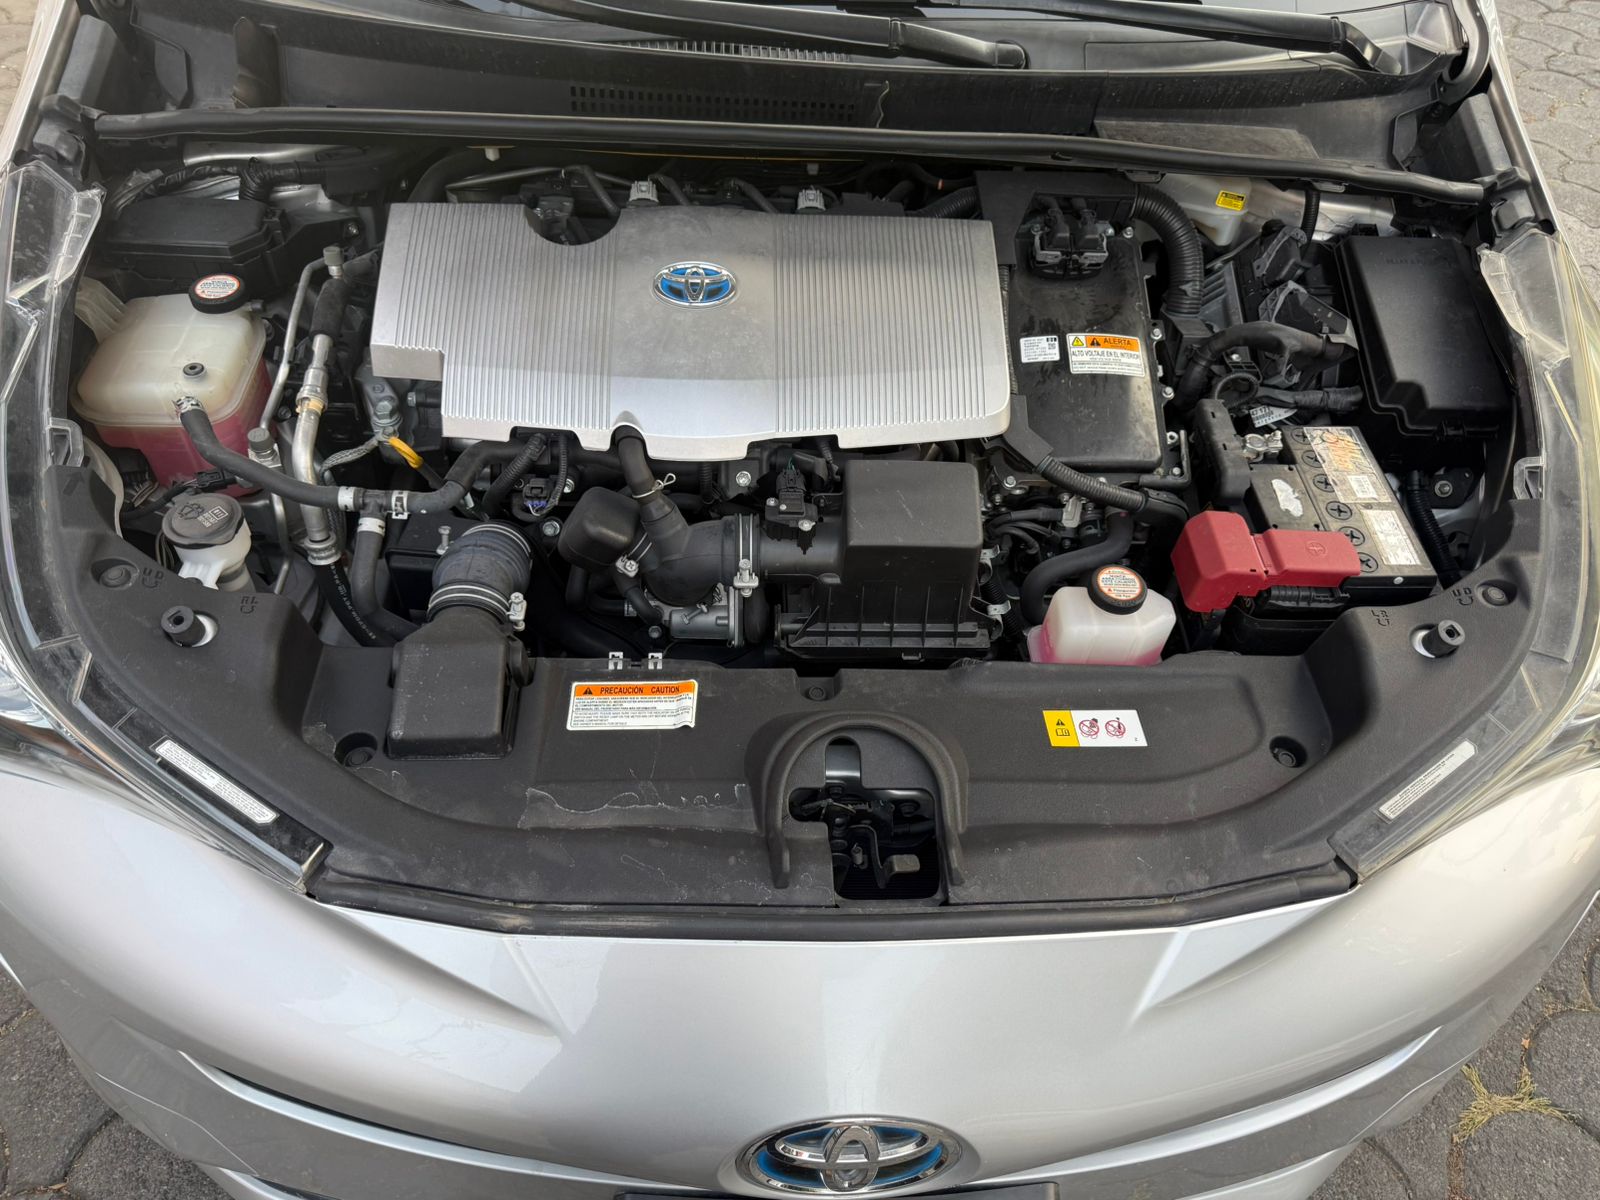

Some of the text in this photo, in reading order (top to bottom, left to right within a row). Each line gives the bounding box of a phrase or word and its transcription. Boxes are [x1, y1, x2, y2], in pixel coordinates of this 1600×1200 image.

[1103, 338, 1132, 346] ALERTA
[1085, 350, 1106, 358] VOLTAJE
[1120, 352, 1140, 360] INTERIOR
[600, 685, 680, 695] PRECAUCIÓN CAUTION
